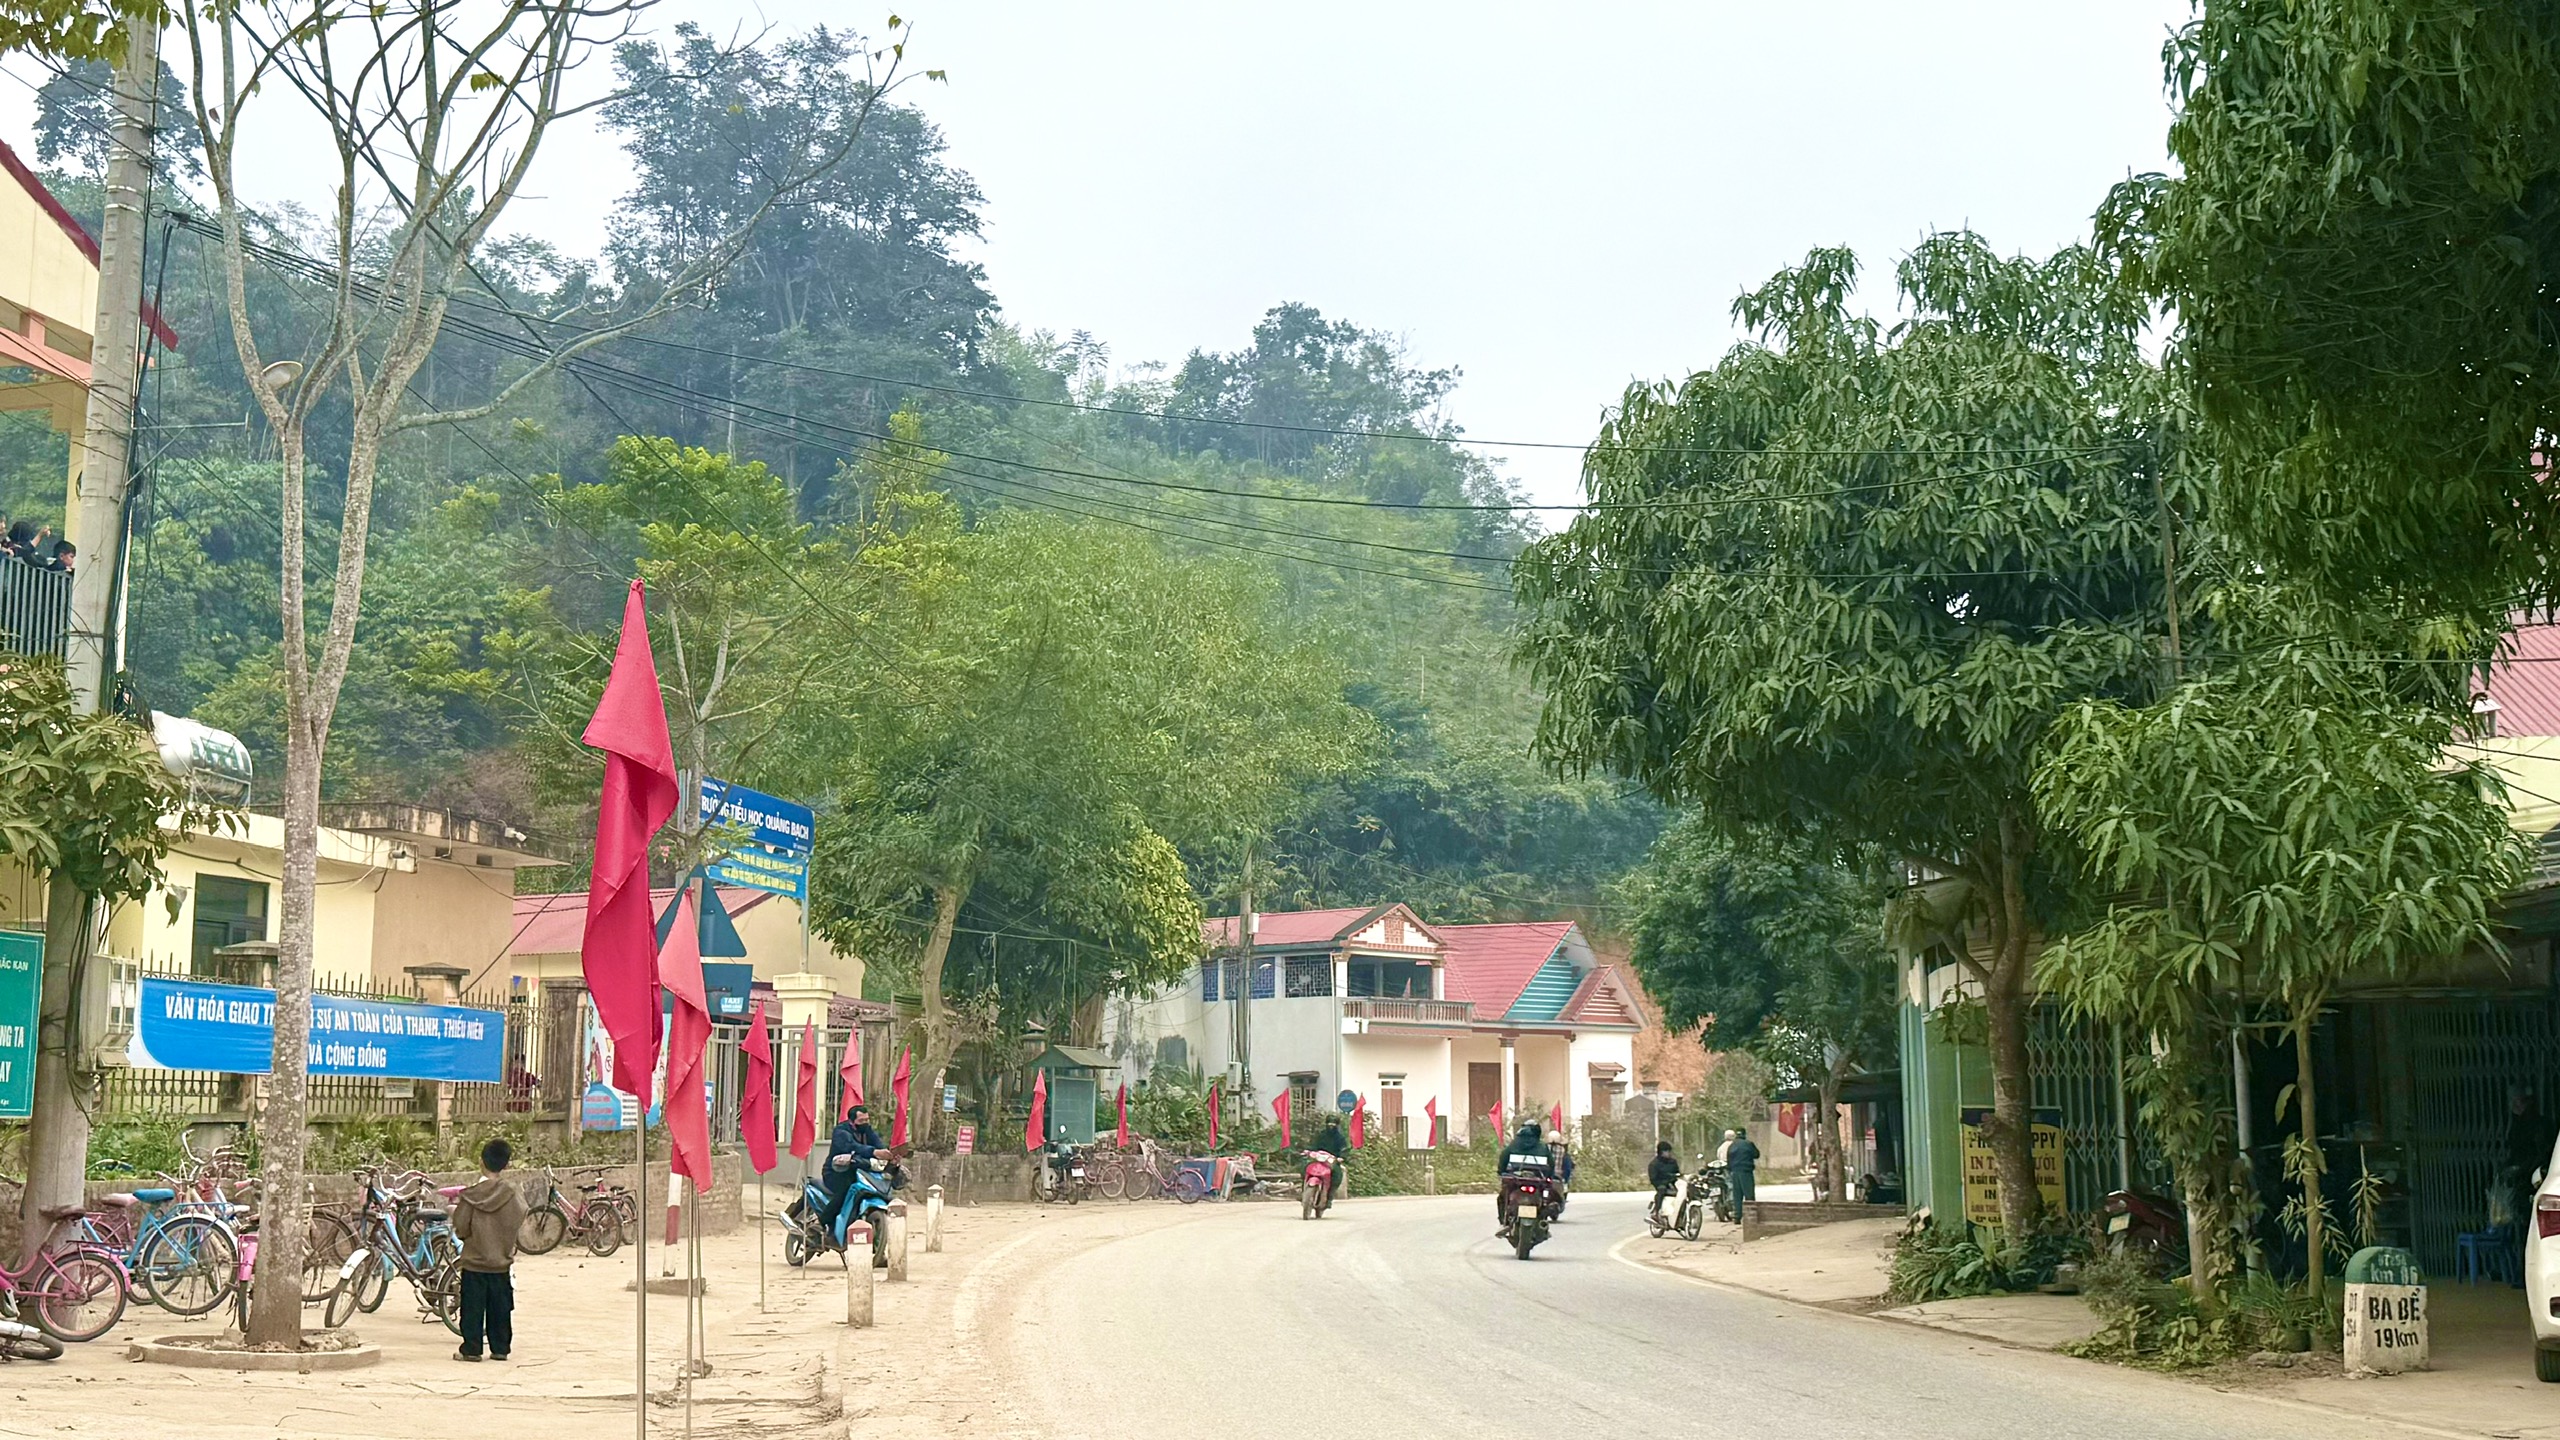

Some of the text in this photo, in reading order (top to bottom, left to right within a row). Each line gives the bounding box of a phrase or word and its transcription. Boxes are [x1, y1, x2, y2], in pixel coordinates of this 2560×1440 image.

[730, 798, 747, 823] TIỂU
[765, 811, 790, 835] QUẢNG
[790, 821, 810, 842] BẠCH
[165, 992, 193, 1019] VĂN
[197, 995, 225, 1022] HÓA
[229, 1002, 260, 1025] GIAO
[316, 1008, 331, 1034] SỰ
[335, 1010, 349, 1031] AN
[351, 1009, 380, 1033] TOÀN
[382, 1008, 404, 1035] CỦA
[405, 1016, 441, 1040] THANH,
[444, 1013, 466, 1039] THIẾU
[13, 1026, 24, 1048] TA
[308, 1040, 386, 1070] VÀ CỘNG ĐỒNG
[1970, 1156, 1984, 1170] IN
[1984, 1189, 1997, 1200] IN
[2371, 1263, 2394, 1284] km
[2368, 1288, 2421, 1323] BA BỂ
